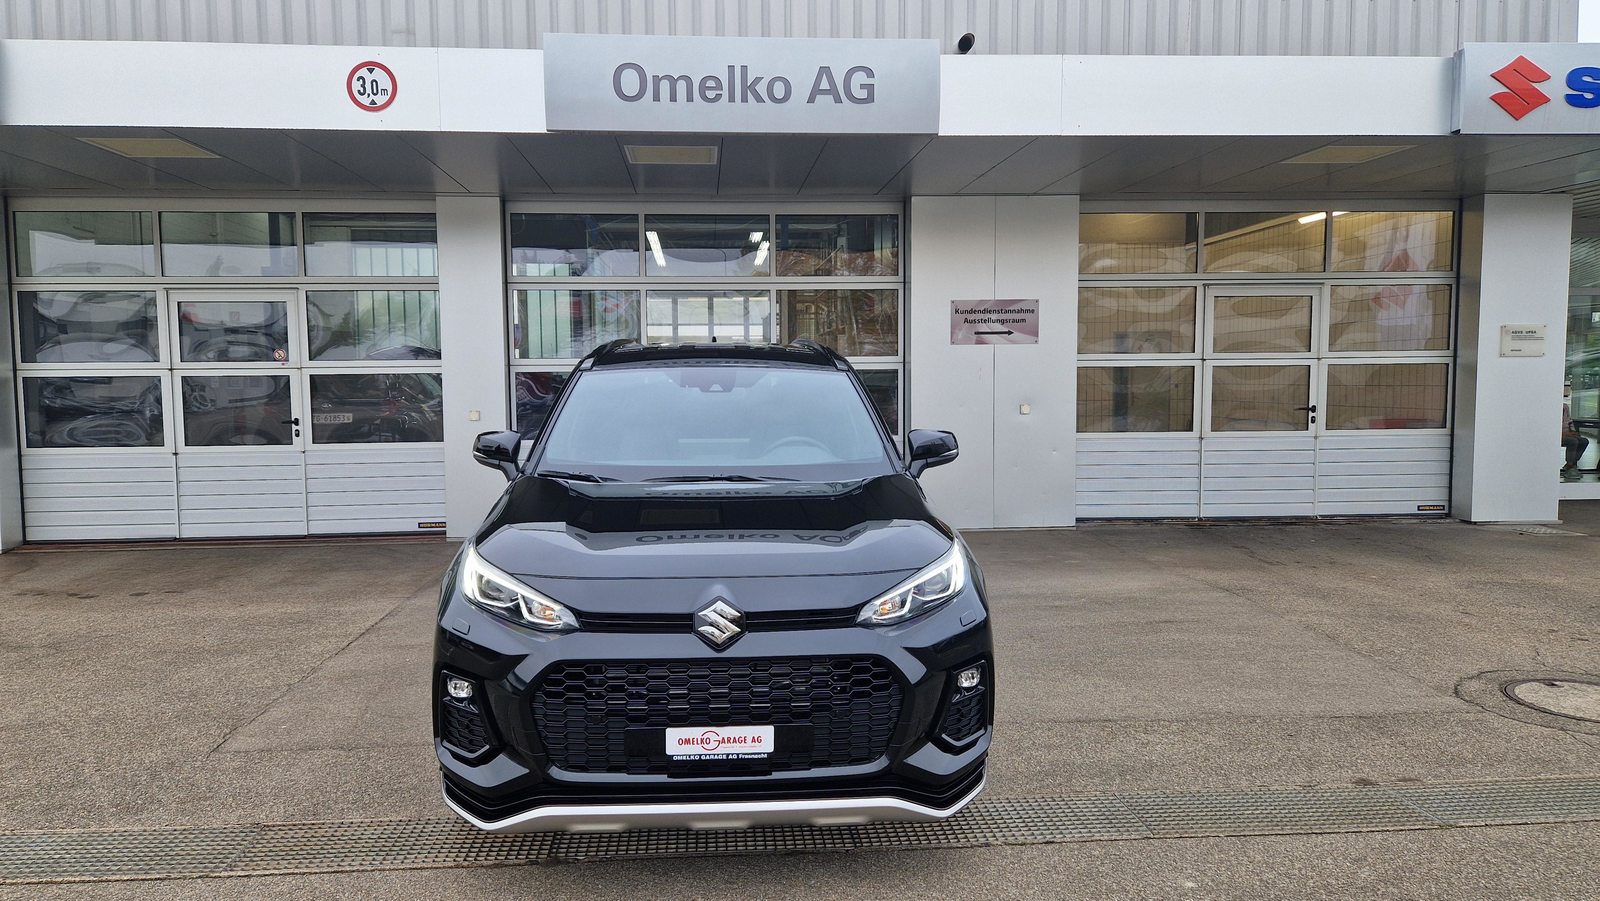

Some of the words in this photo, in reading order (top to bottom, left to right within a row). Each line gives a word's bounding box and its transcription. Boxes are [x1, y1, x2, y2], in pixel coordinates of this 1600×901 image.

[612, 62, 792, 104] Omelko
[806, 65, 876, 104] AG
[963, 317, 1027, 325] Ausstellungsraum
[677, 737, 711, 746] OMELKO
[751, 735, 763, 744] AG
[729, 752, 738, 760] AG
